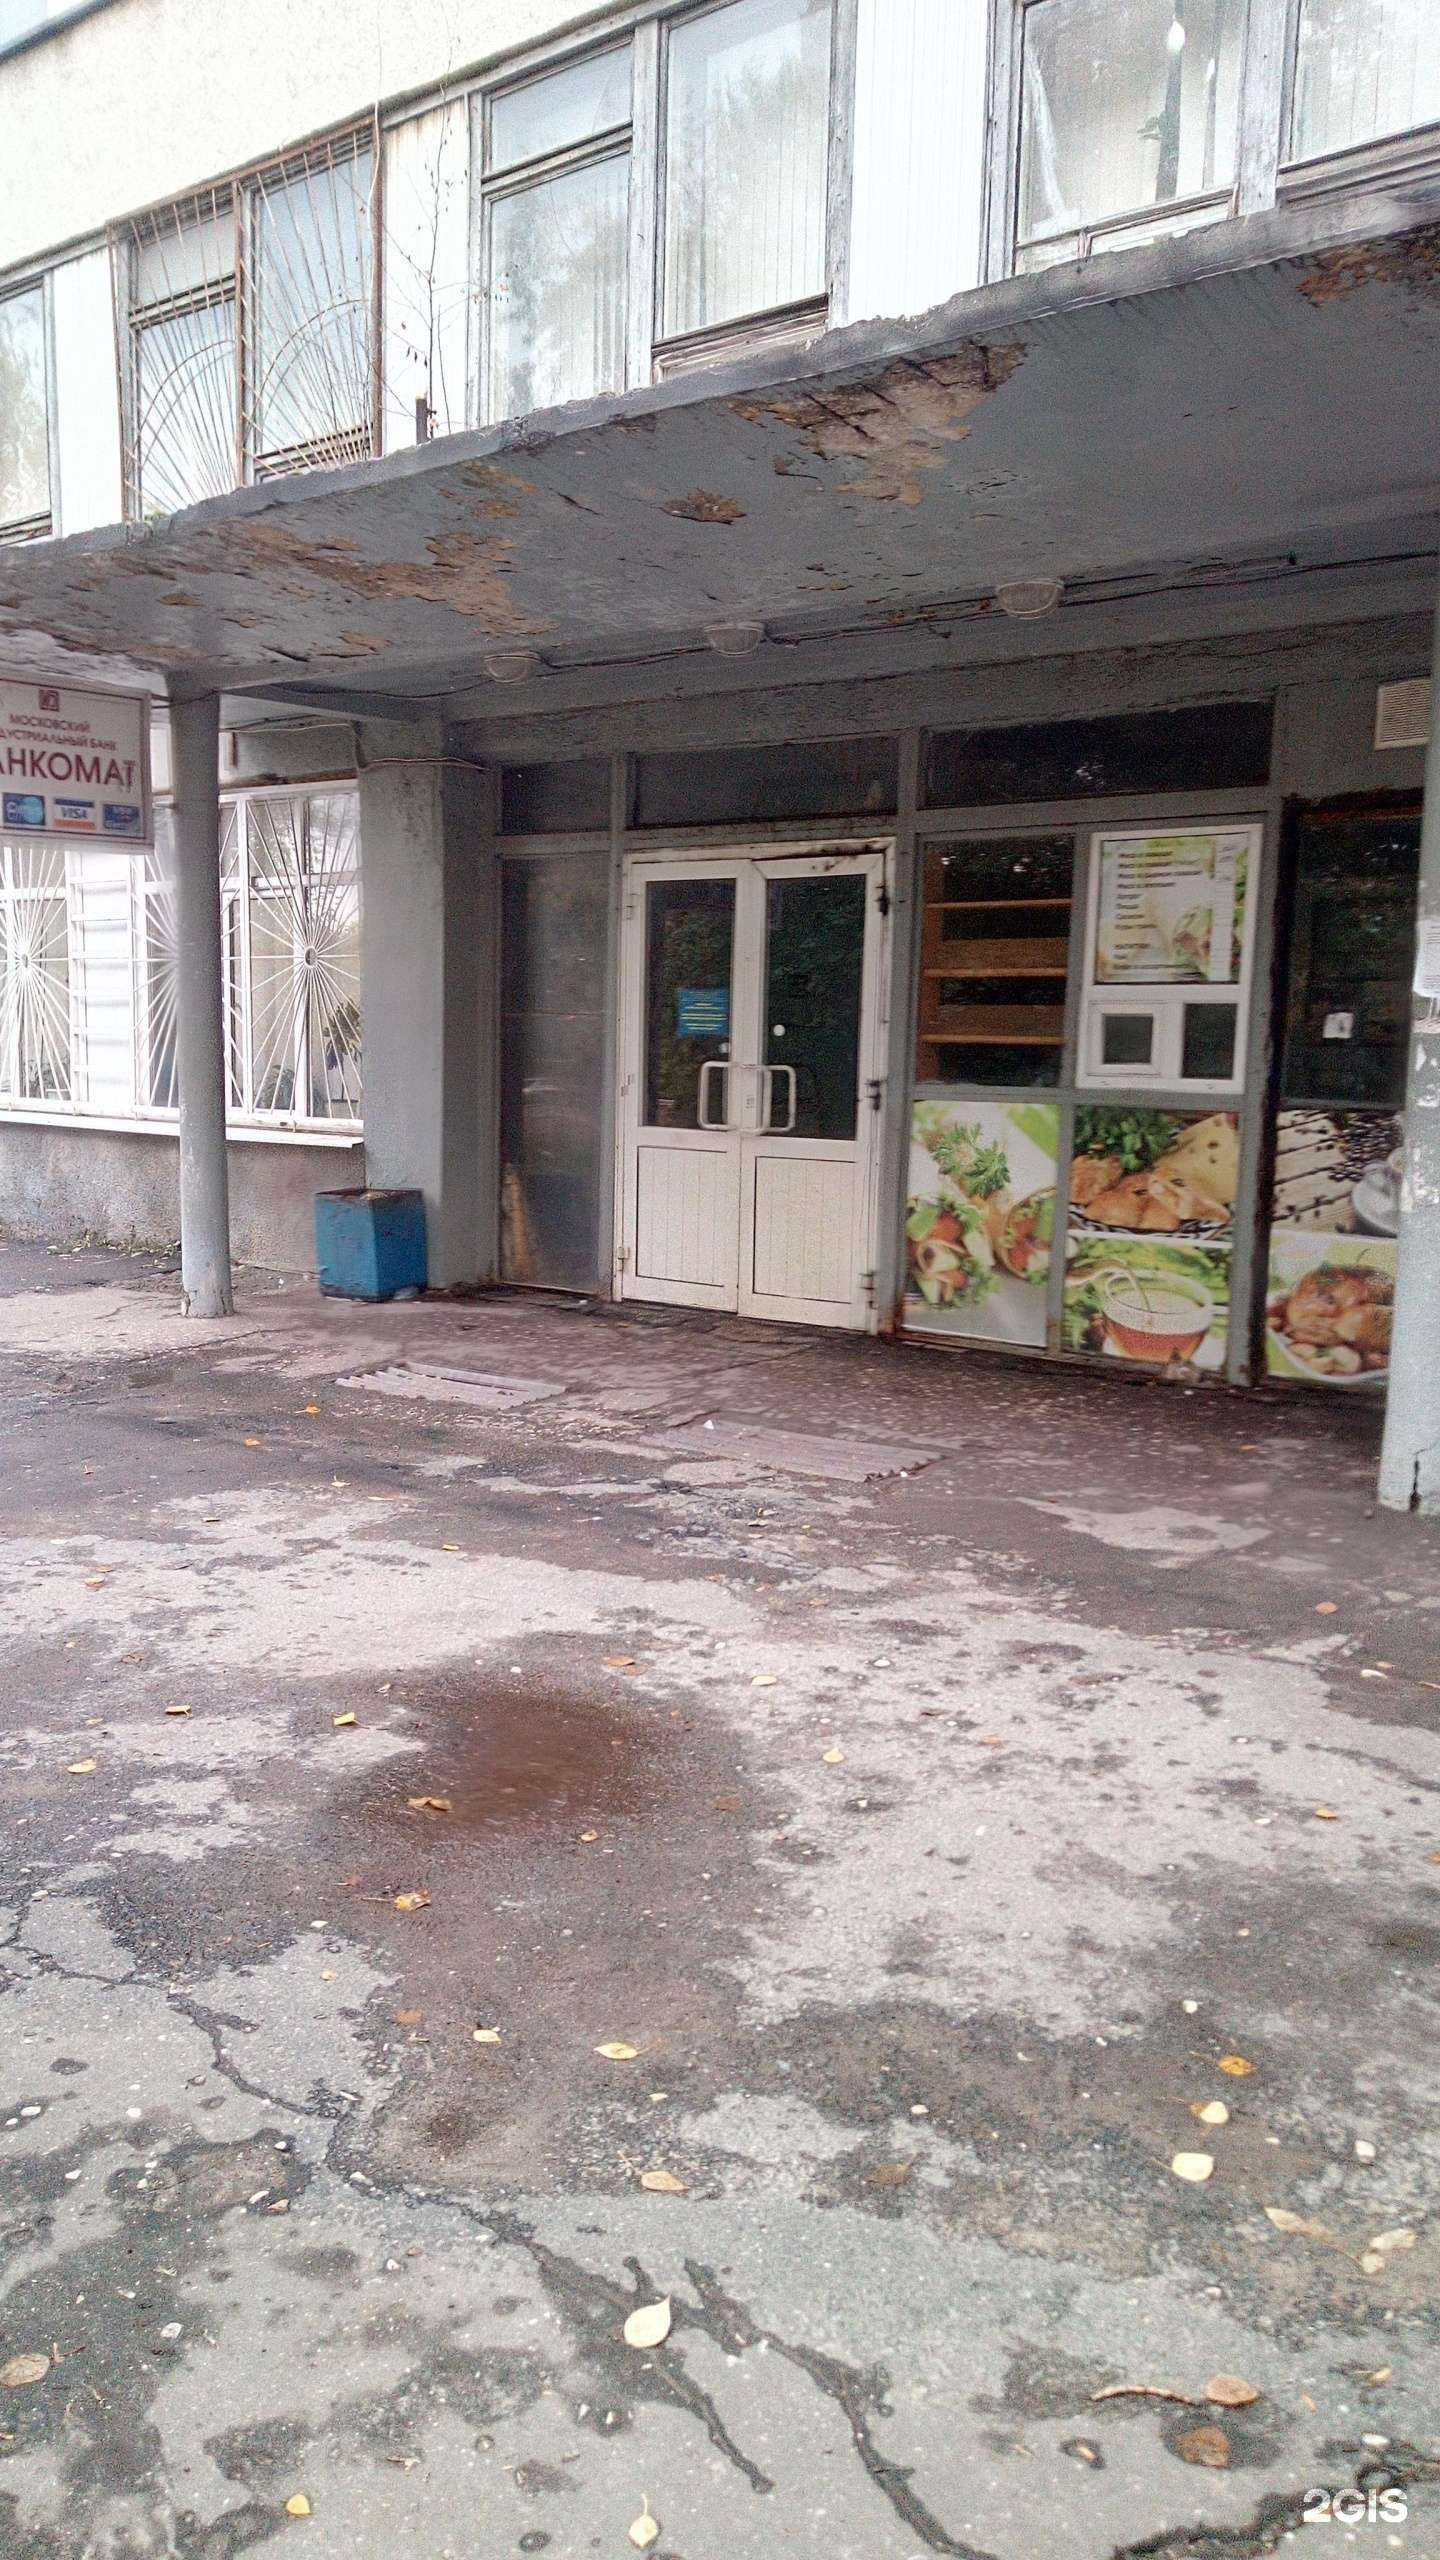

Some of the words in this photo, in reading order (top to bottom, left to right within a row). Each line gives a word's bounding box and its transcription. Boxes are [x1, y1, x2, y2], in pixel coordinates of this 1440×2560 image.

[9, 713, 90, 733] МОСКОВСКИЙ
[90, 738, 116, 751] БАНК
[0, 747, 136, 787] НКОМАТ
[61, 806, 87, 819] VISA
